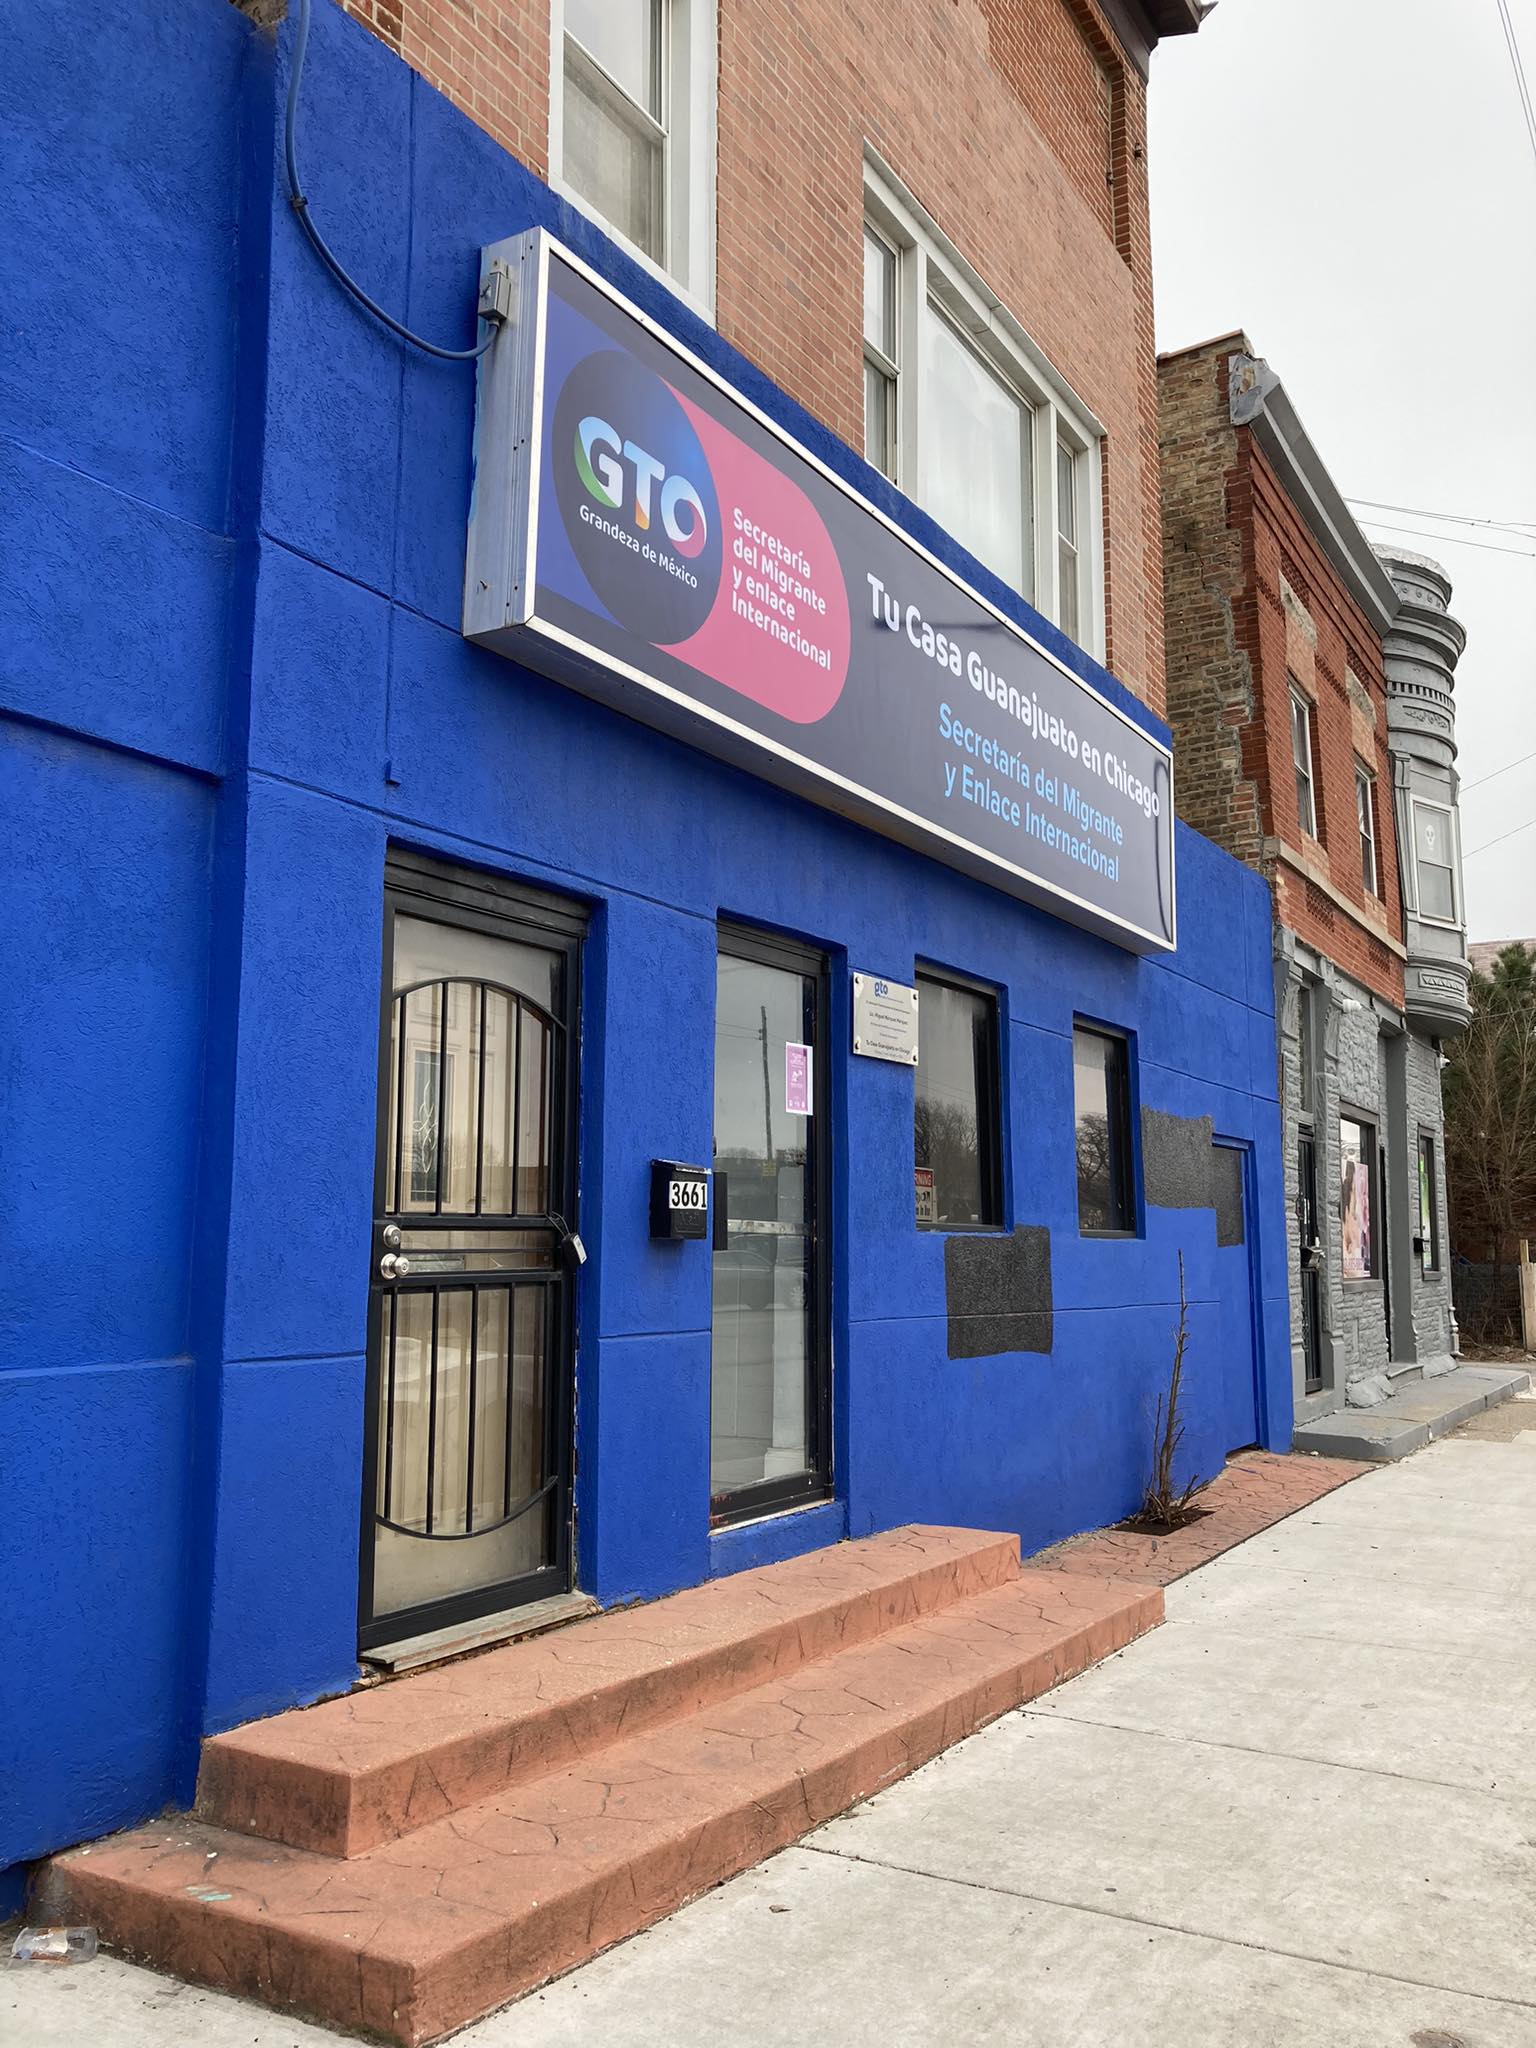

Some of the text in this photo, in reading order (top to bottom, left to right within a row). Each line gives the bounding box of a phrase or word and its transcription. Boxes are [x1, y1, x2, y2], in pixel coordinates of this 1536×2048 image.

[574, 416, 707, 558] GTO
[579, 505, 698, 588] Grandeza de México
[733, 508, 811, 579] Secretaría
[733, 537, 826, 615] del Migrante
[732, 566, 795, 621] y enlace
[732, 591, 831, 671] Internacional
[867, 572, 1160, 818] Tu Casa Guanajuato en Chicago
[939, 702, 1124, 846] Secretaría del Migrante
[943, 762, 1120, 882] y Enlace Internacional
[874, 980, 888, 997] gto
[672, 1183, 706, 1208] 3661
